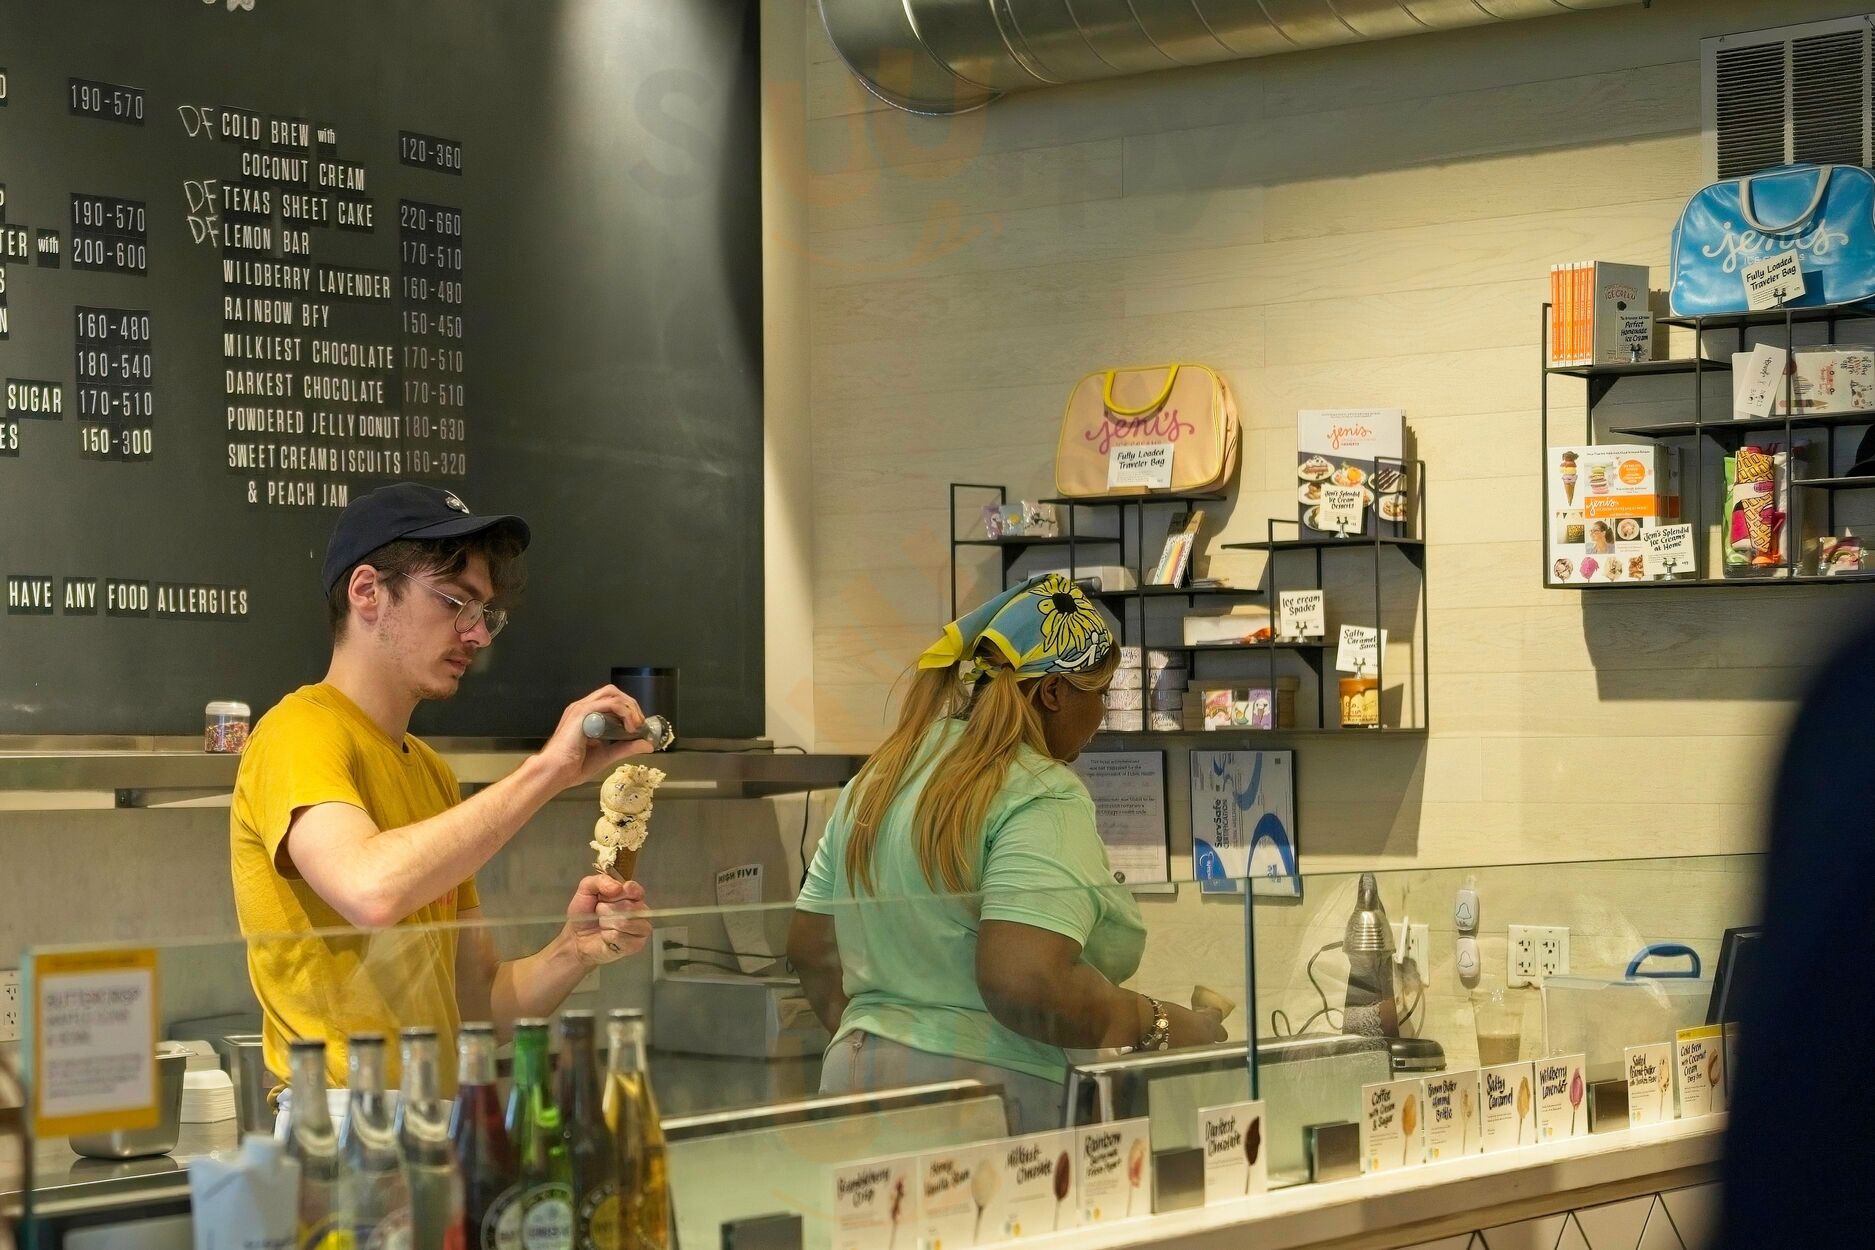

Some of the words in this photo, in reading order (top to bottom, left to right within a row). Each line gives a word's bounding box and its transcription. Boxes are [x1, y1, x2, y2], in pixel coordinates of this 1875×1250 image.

[72, 84, 143, 119] 190-570
[177, 105, 214, 140] DF
[222, 112, 260, 140] COLD
[271, 121, 309, 147] BREW
[317, 127, 336, 144] with
[402, 137, 461, 169] 120-360
[242, 152, 308, 183] COCONUT
[319, 163, 365, 191] CREAM
[184, 180, 217, 214] DF
[223, 186, 270, 214] TEXAS
[282, 194, 328, 221] SHEET
[338, 202, 373, 227] CAKE
[74, 200, 145, 232] 190-570
[401, 205, 461, 236] 220-660
[38, 237, 59, 253] with
[186, 215, 219, 248] DF
[224, 223, 271, 250] LEMON
[283, 231, 309, 255] BAR
[74, 239, 145, 269] 200-600
[402, 241, 461, 270] 170-510
[223, 260, 310, 291] WILDBERRY
[319, 269, 390, 299] LAVENDER
[1746, 270, 1765, 282] Fully
[1767, 256, 1793, 274] Loaded
[1750, 273, 1780, 291] Traveler
[1781, 265, 1797, 279] Bag
[403, 276, 462, 304] 160-480
[78, 312, 149, 340] 160-480
[224, 297, 292, 325] RAINBOW
[302, 304, 329, 328] BFY
[403, 311, 462, 338] 150-450
[224, 333, 301, 361] MILKIEST
[312, 340, 393, 368] CHOCOLATE
[404, 347, 463, 373] 170-510
[79, 351, 151, 379] 180-540
[8, 384, 62, 413] SUGAR
[226, 370, 293, 397] DARKEST
[303, 375, 384, 404] CHOCOLATE
[405, 381, 463, 407] 170-510
[80, 390, 152, 417] 170-510
[227, 407, 304, 434] POWDERED
[312, 412, 355, 437] JELLY
[359, 416, 400, 439] DONUT
[405, 415, 464, 441] 180-630
[82, 427, 152, 455] 150-300
[228, 443, 275, 468] SWEET
[406, 450, 465, 475] 160-320
[1117, 451, 1136, 461] Fully
[1138, 449, 1165, 459] Loaded
[1119, 459, 1148, 470] Traveler
[1150, 457, 1165, 467] Bag
[248, 480, 258, 503] &
[268, 481, 315, 506] PEACH
[322, 483, 348, 508] JAM
[1643, 530, 1661, 542] Jeni's
[1662, 526, 1690, 537] Splendid
[1650, 539, 1659, 547] Ice
[1660, 534, 1686, 544] Creams
[1663, 540, 1682, 551] Home
[9, 580, 52, 608] HAVE
[65, 582, 96, 608] ANY
[108, 584, 148, 610] FOOD
[157, 587, 248, 615] ALLERGIES
[1282, 597, 1294, 608] Ice
[1289, 603, 1316, 616] Spades
[1344, 629, 1365, 640] Salty
[1347, 636, 1377, 645] Caramel
[718, 872, 736, 884] HIGH
[737, 867, 759, 879] FIVE
[1487, 1073, 1506, 1095] Salty
[1540, 1065, 1568, 1085] Wildberry
[1371, 1088, 1391, 1107] Coffee
[1488, 1086, 1513, 1110] Caramel
[1542, 1079, 1568, 1100] Lavender
